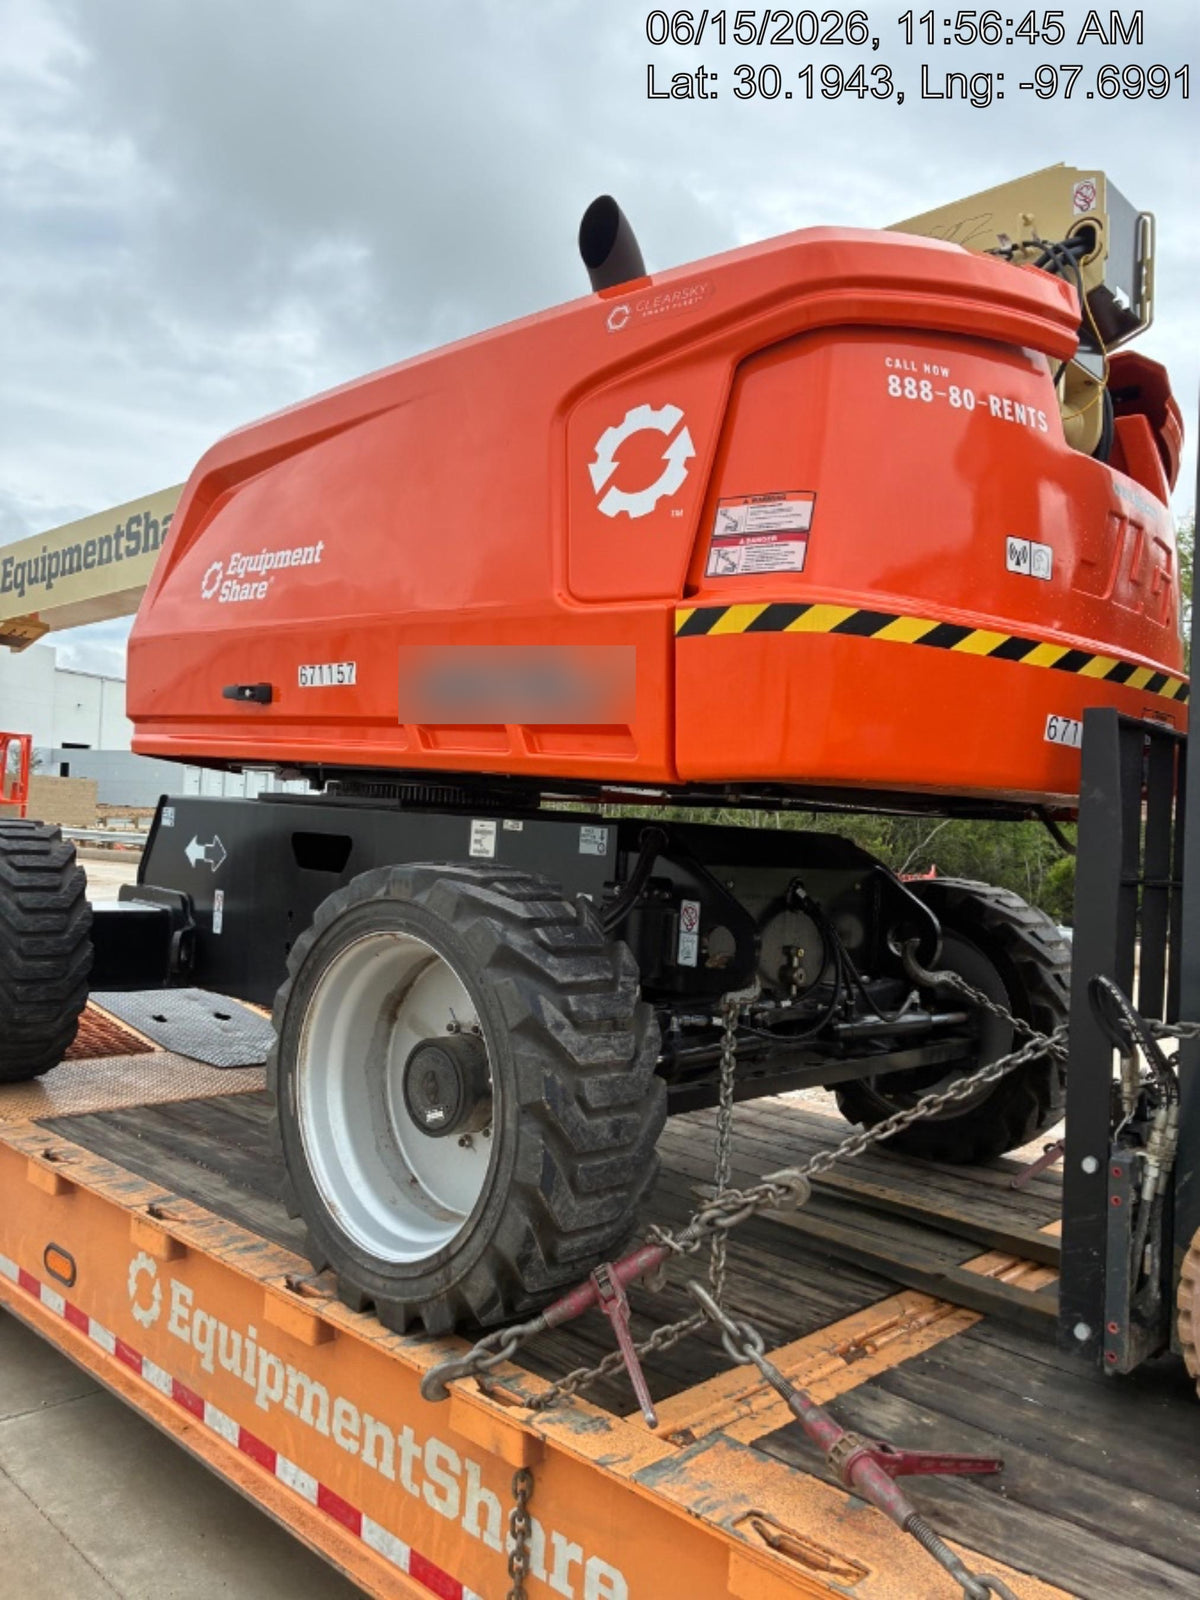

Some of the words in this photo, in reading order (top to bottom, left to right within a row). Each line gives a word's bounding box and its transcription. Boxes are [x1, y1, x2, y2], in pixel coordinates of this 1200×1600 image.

[636, 282, 708, 312] CLEARSKY
[885, 357, 918, 371] CALL
[923, 363, 949, 378] NOW
[888, 374, 1049, 432] 888-80-RENTS
[226, 540, 325, 578] Equipment
[299, 662, 355, 686] 671157
